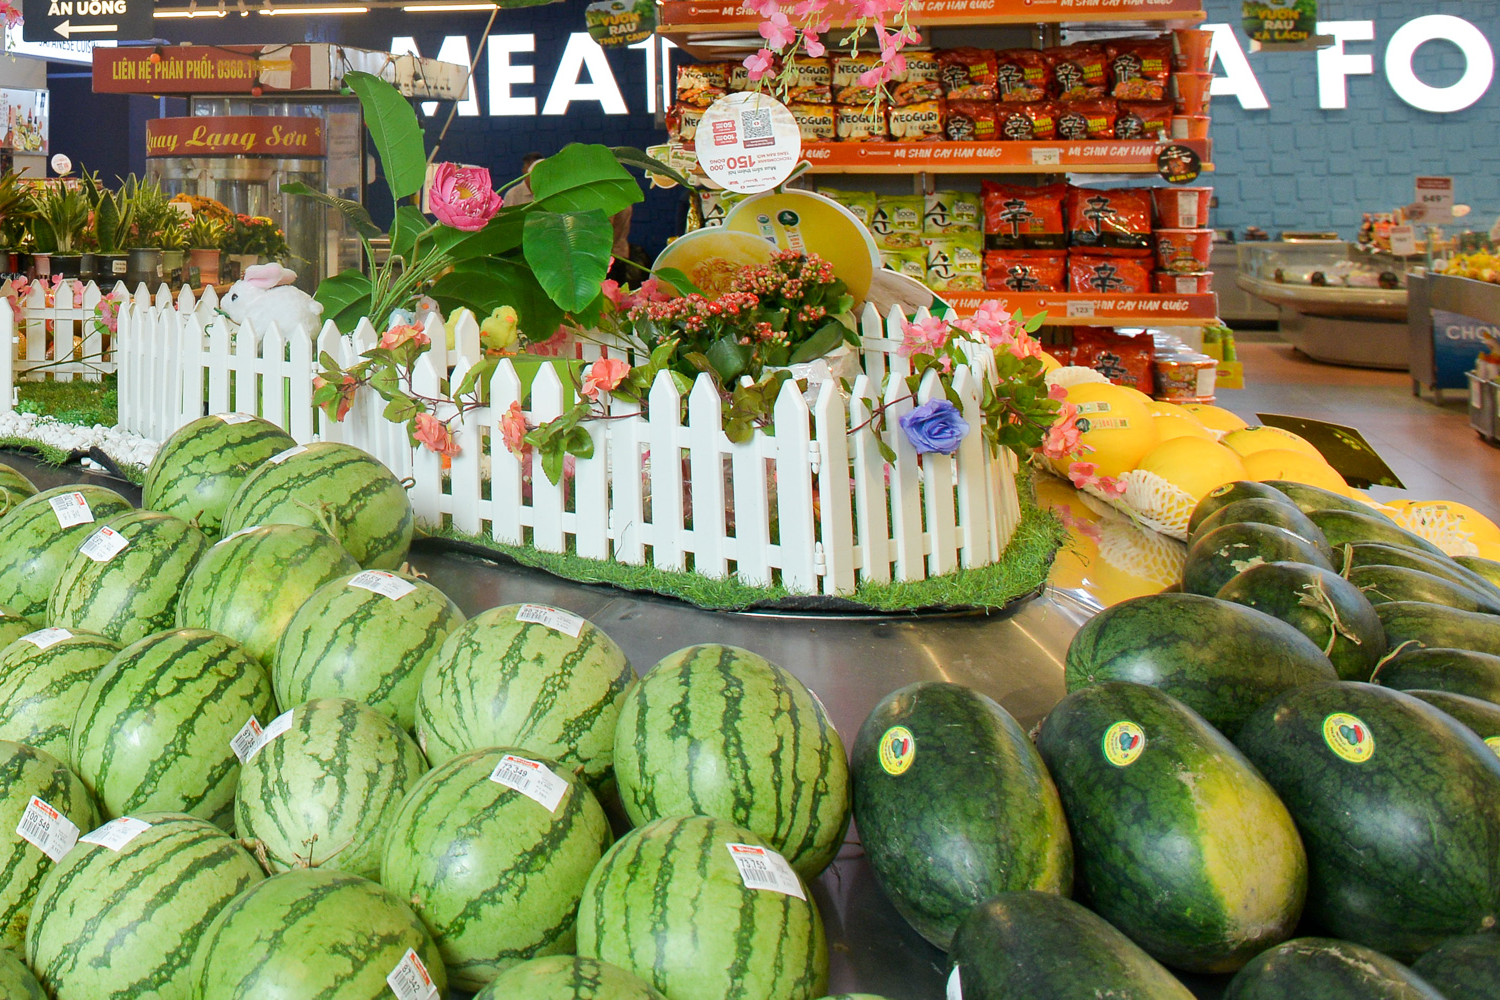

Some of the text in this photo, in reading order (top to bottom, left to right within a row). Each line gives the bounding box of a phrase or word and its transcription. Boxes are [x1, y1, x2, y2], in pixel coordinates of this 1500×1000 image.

[927, 1, 946, 11] CAY
[608, 23, 637, 35] RAU
[1263, 20, 1295, 30] RAU
[112, 53, 215, 83] LIÊN HỆ PHÂN PHỐI:
[840, 115, 883, 124] NEOGURI
[893, 113, 938, 123] NEOGURI
[185, 125, 258, 150] Lạng
[265, 125, 309, 147] Sơn
[908, 147, 953, 159] SHIN CAY
[1083, 146, 1129, 157] SHIN CAY
[726, 155, 756, 170] 150
[925, 201, 952, 227] 순
[1001, 198, 1034, 238] 辛
[928, 250, 956, 279] 순
[1116, 300, 1137, 310] CAY
